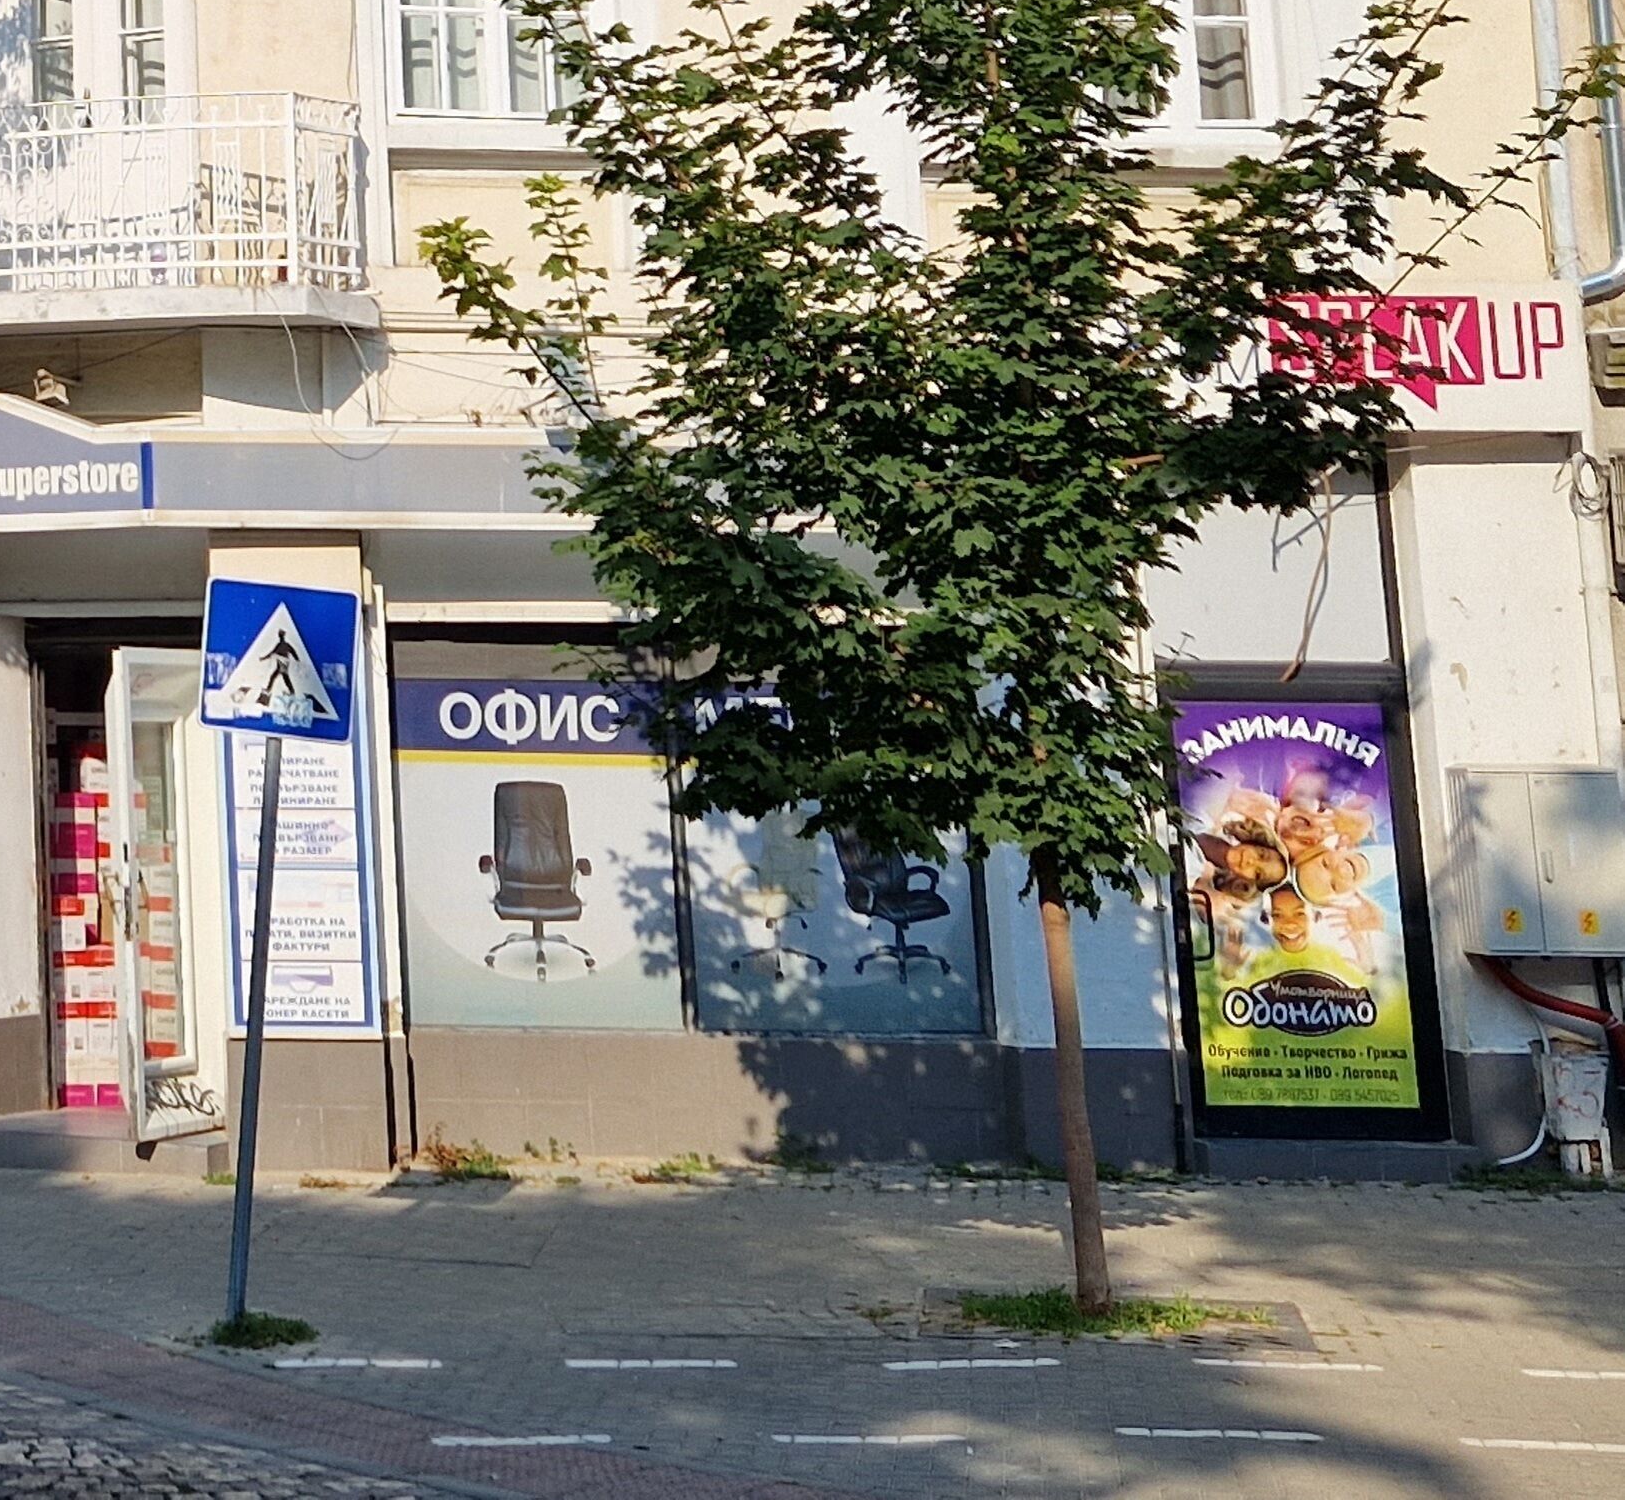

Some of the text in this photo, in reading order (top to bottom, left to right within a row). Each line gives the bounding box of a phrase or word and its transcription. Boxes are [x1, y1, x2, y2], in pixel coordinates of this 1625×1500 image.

[439, 688, 620, 746] ОФИС
[1181, 715, 1381, 768] ЗАНИМАЛНЯ
[283, 846, 332, 855] РАЗМЕР
[330, 917, 346, 926] НА
[300, 930, 357, 939] ВИЗИТКИ
[272, 942, 330, 951] ФАКТУРИ
[265, 996, 351, 1006] АРЕЖДАНЕ НА
[266, 1009, 349, 1018] ОНЕР КАСЕТИ
[1208, 1044, 1408, 1062] Обучение Творчество Грижа
[1286, 1067, 1301, 1079] за
[1305, 1065, 1332, 1079] НВО
[1342, 1067, 1399, 1082] Логопед
